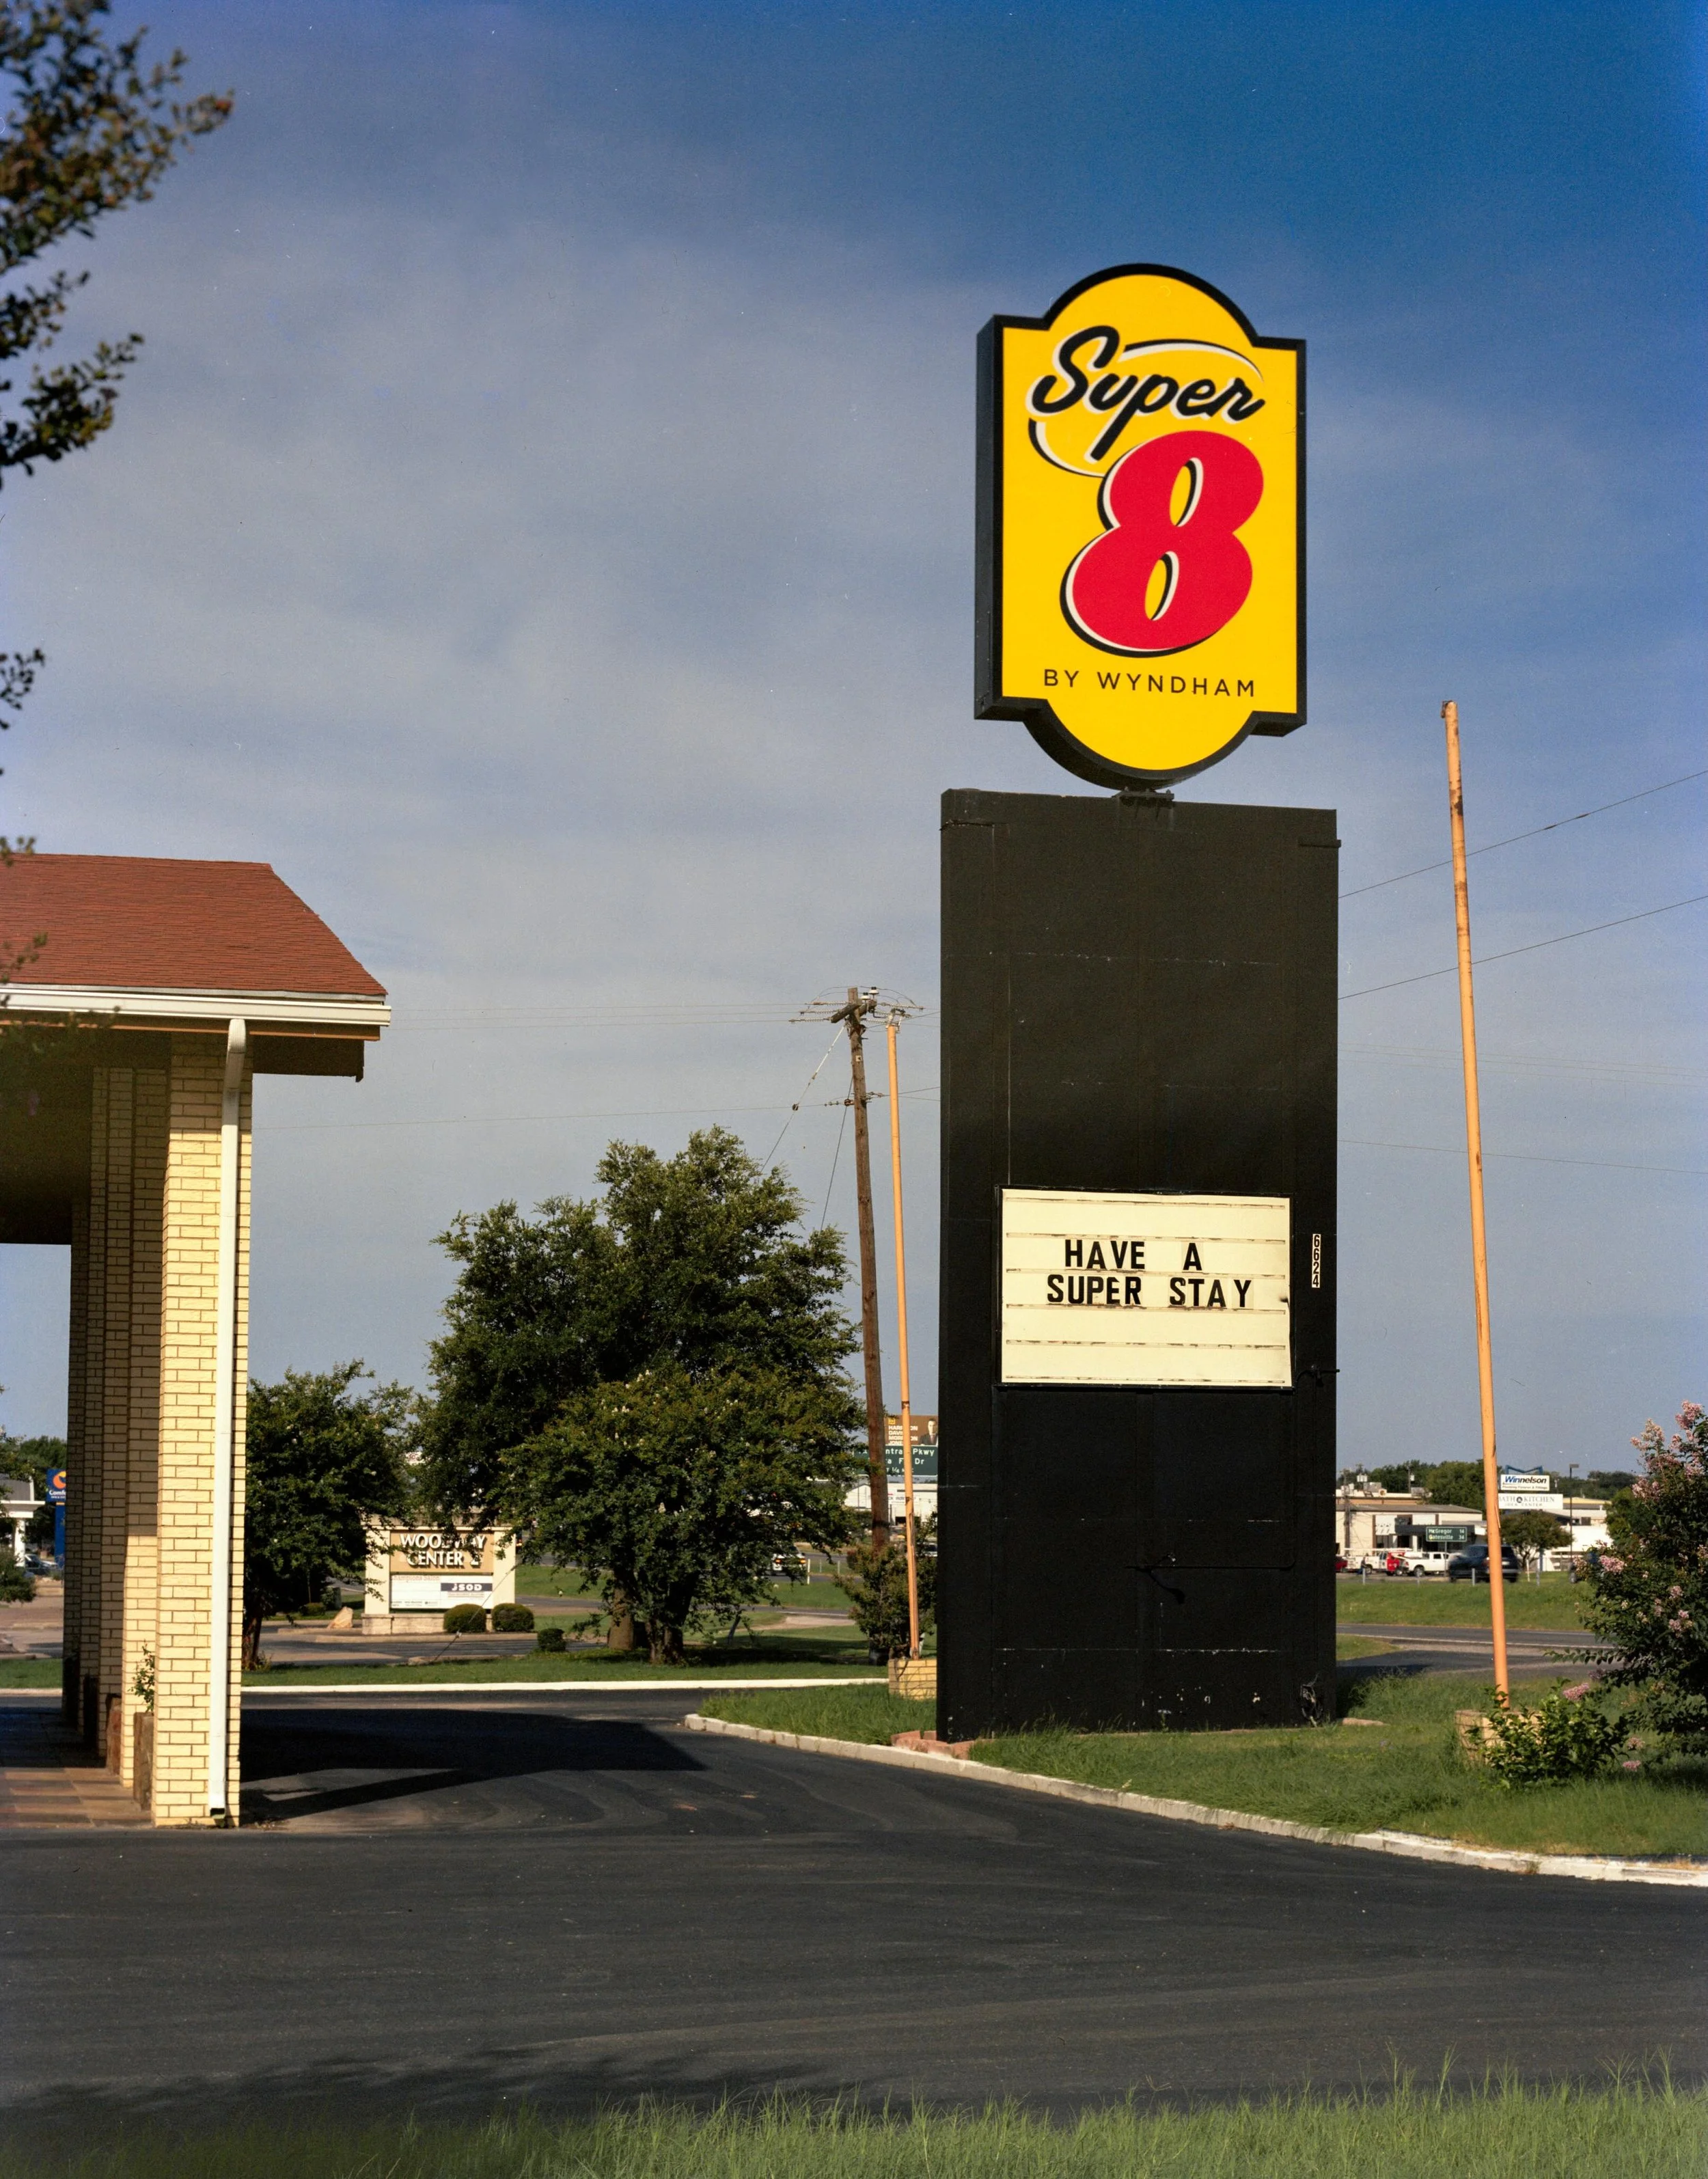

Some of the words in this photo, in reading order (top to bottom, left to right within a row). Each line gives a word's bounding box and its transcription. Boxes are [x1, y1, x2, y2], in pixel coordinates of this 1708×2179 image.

[1030, 325, 1265, 463] Super
[1060, 430, 1264, 657] 8
[1043, 668, 1079, 687] BY
[1097, 670, 1255, 697] WYNDHAM
[1064, 1239, 1146, 1270] HAVE
[1183, 1242, 1202, 1271] A
[1047, 1274, 1142, 1306] SUPER
[1169, 1277, 1252, 1308] STAY
[913, 1448, 935, 1457] Pkwy
[1505, 1475, 1547, 1484] Winnelson
[407, 1550, 464, 1566] CENTER
